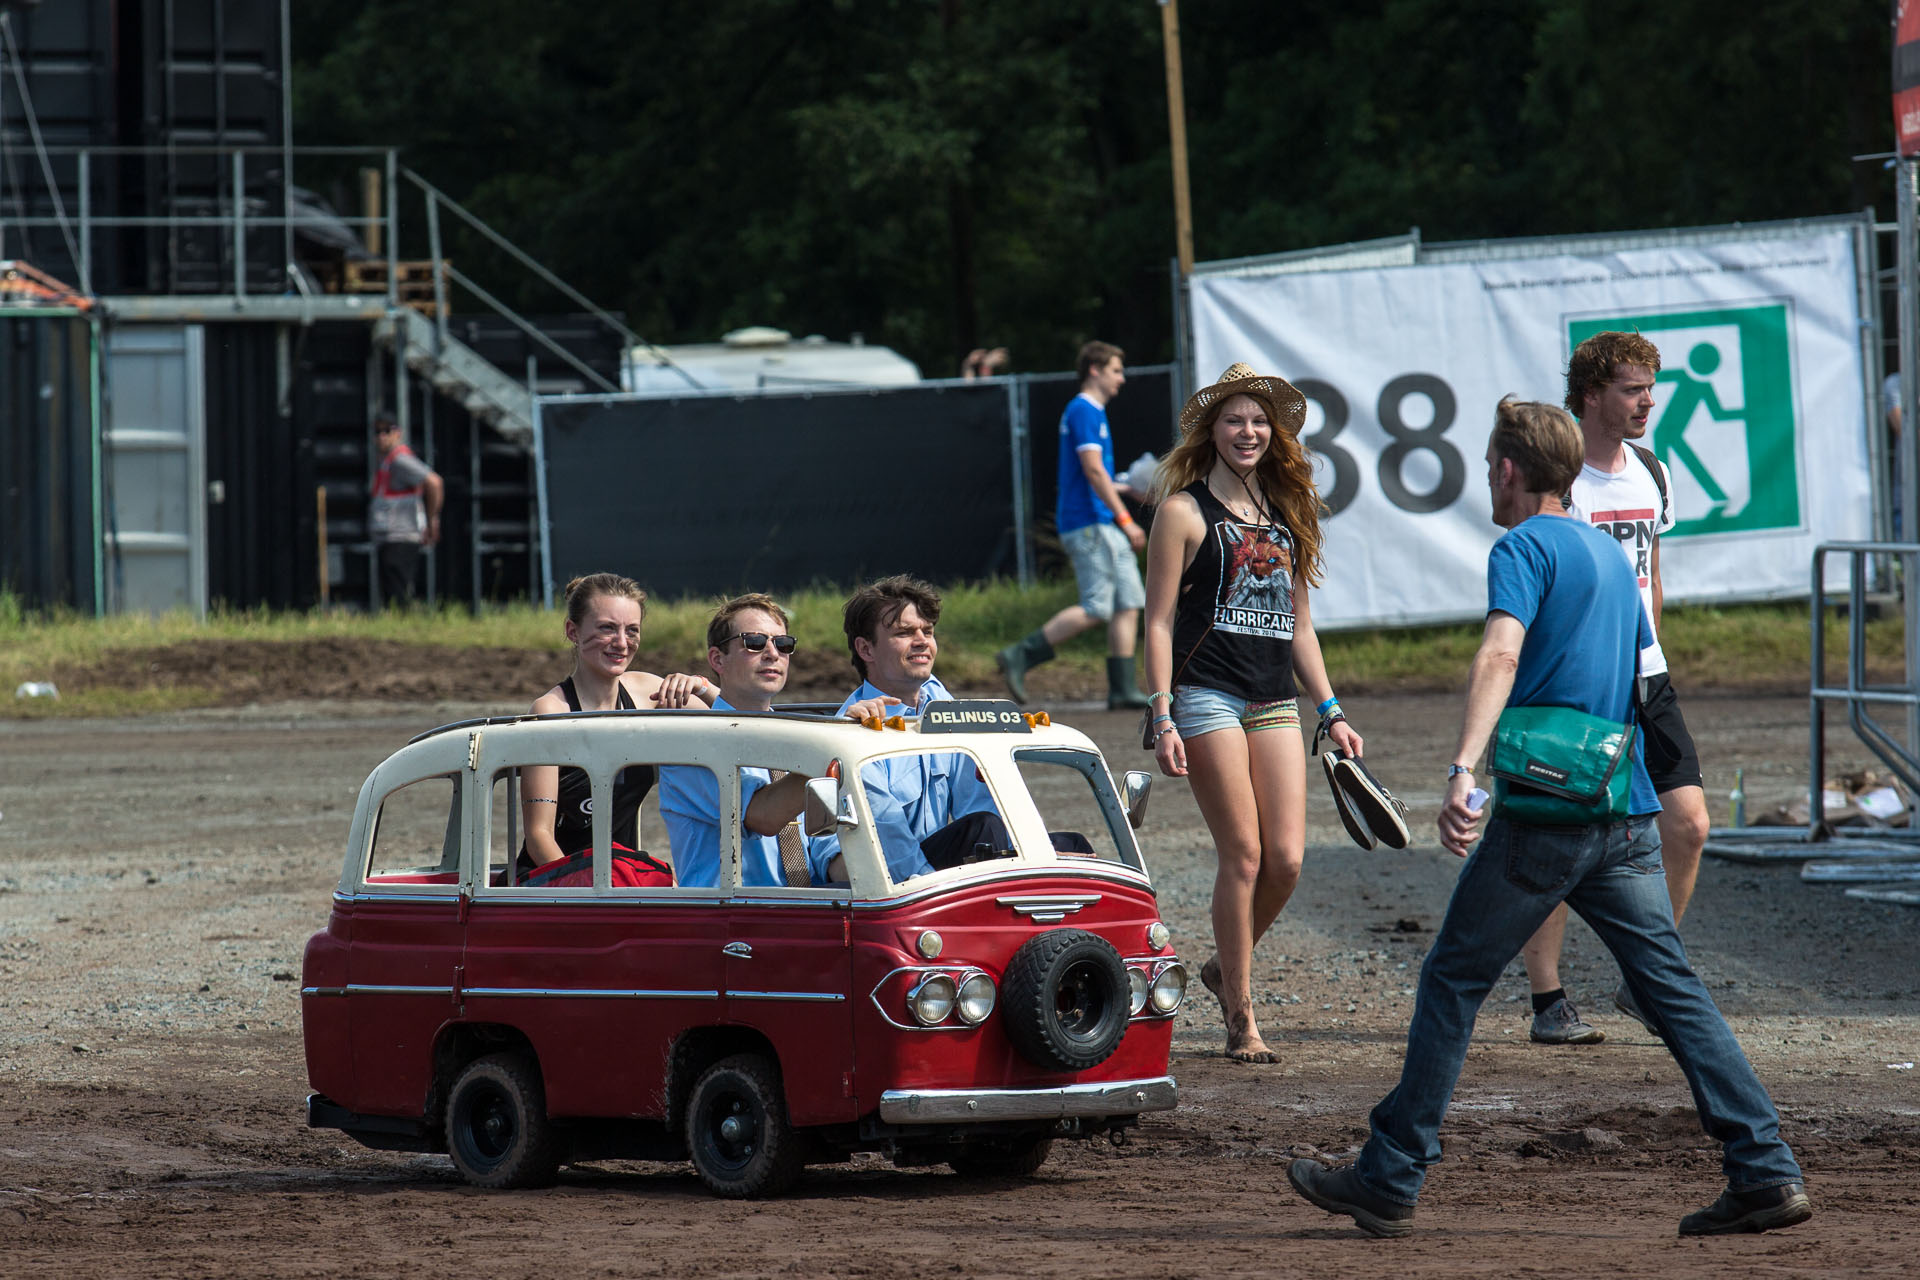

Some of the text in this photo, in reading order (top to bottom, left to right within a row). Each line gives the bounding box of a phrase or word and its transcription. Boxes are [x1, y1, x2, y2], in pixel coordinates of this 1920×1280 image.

[1291, 372, 1466, 519] 38
[930, 711, 1022, 724] DELINUS 03
